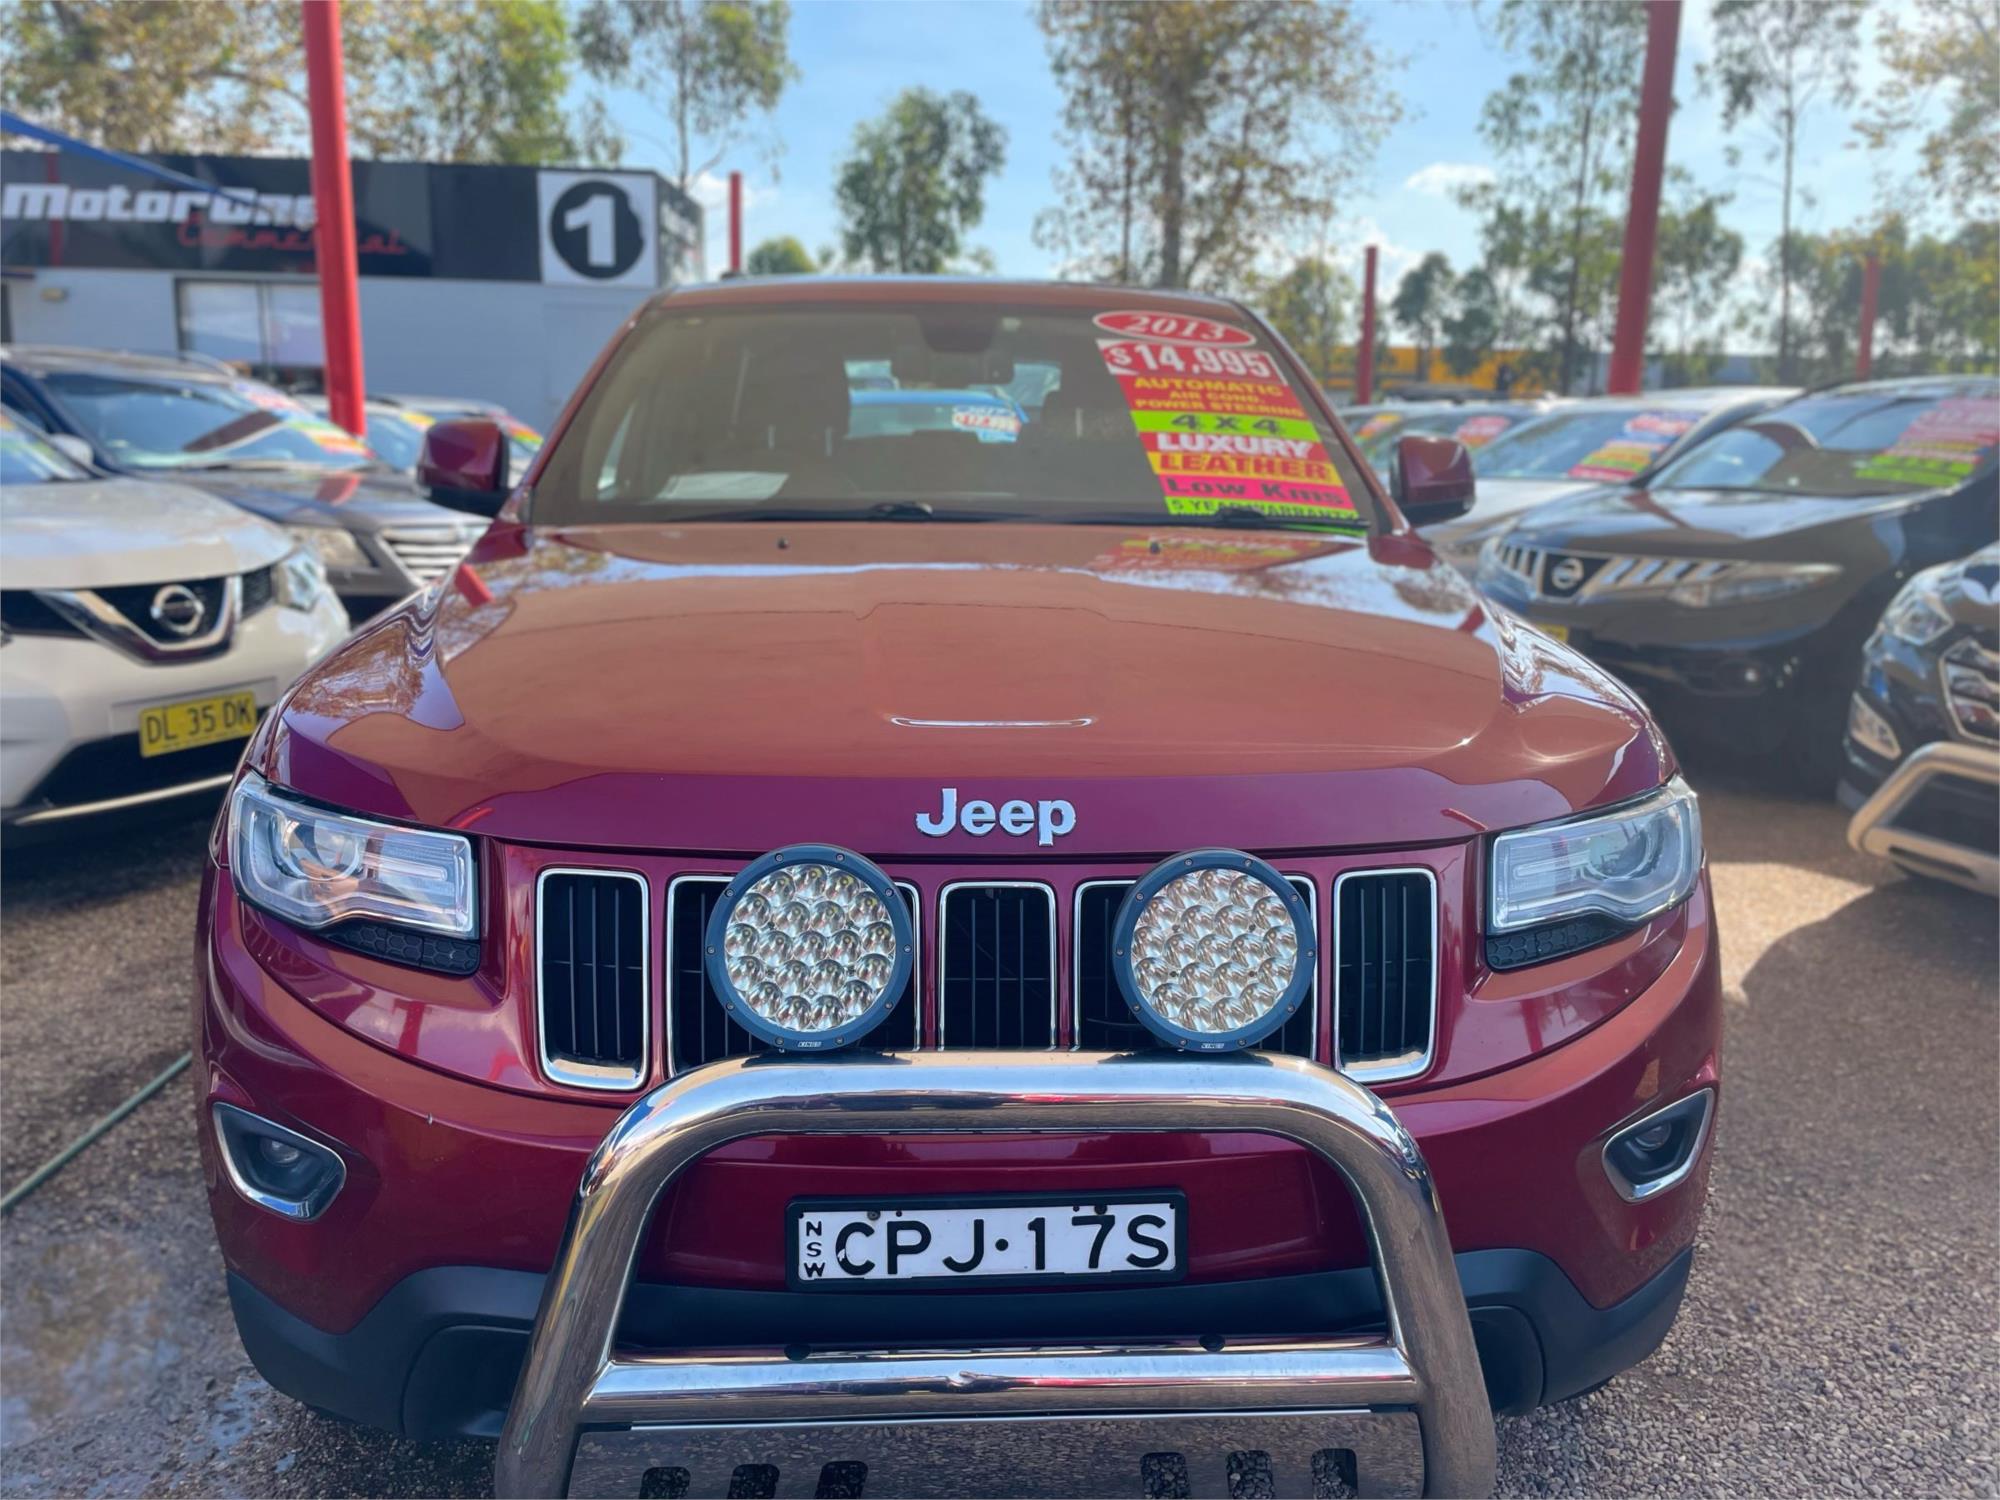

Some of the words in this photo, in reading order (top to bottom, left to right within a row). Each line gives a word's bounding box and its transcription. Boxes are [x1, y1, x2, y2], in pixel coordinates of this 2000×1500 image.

[564, 194, 616, 268] 1
[1124, 314, 1227, 342] 2013
[1109, 344, 1271, 378] $14,995
[1135, 377, 1284, 397] AUTOMATIC
[1169, 391, 1201, 400] AIR
[1135, 399, 1206, 410] POWER
[1210, 401, 1305, 418] STEERING
[1156, 433, 1315, 459] LUXURY
[1159, 453, 1328, 480] LEATHER
[146, 710, 177, 744] DL
[187, 705, 216, 735] 35
[915, 787, 1077, 847] Jeep
